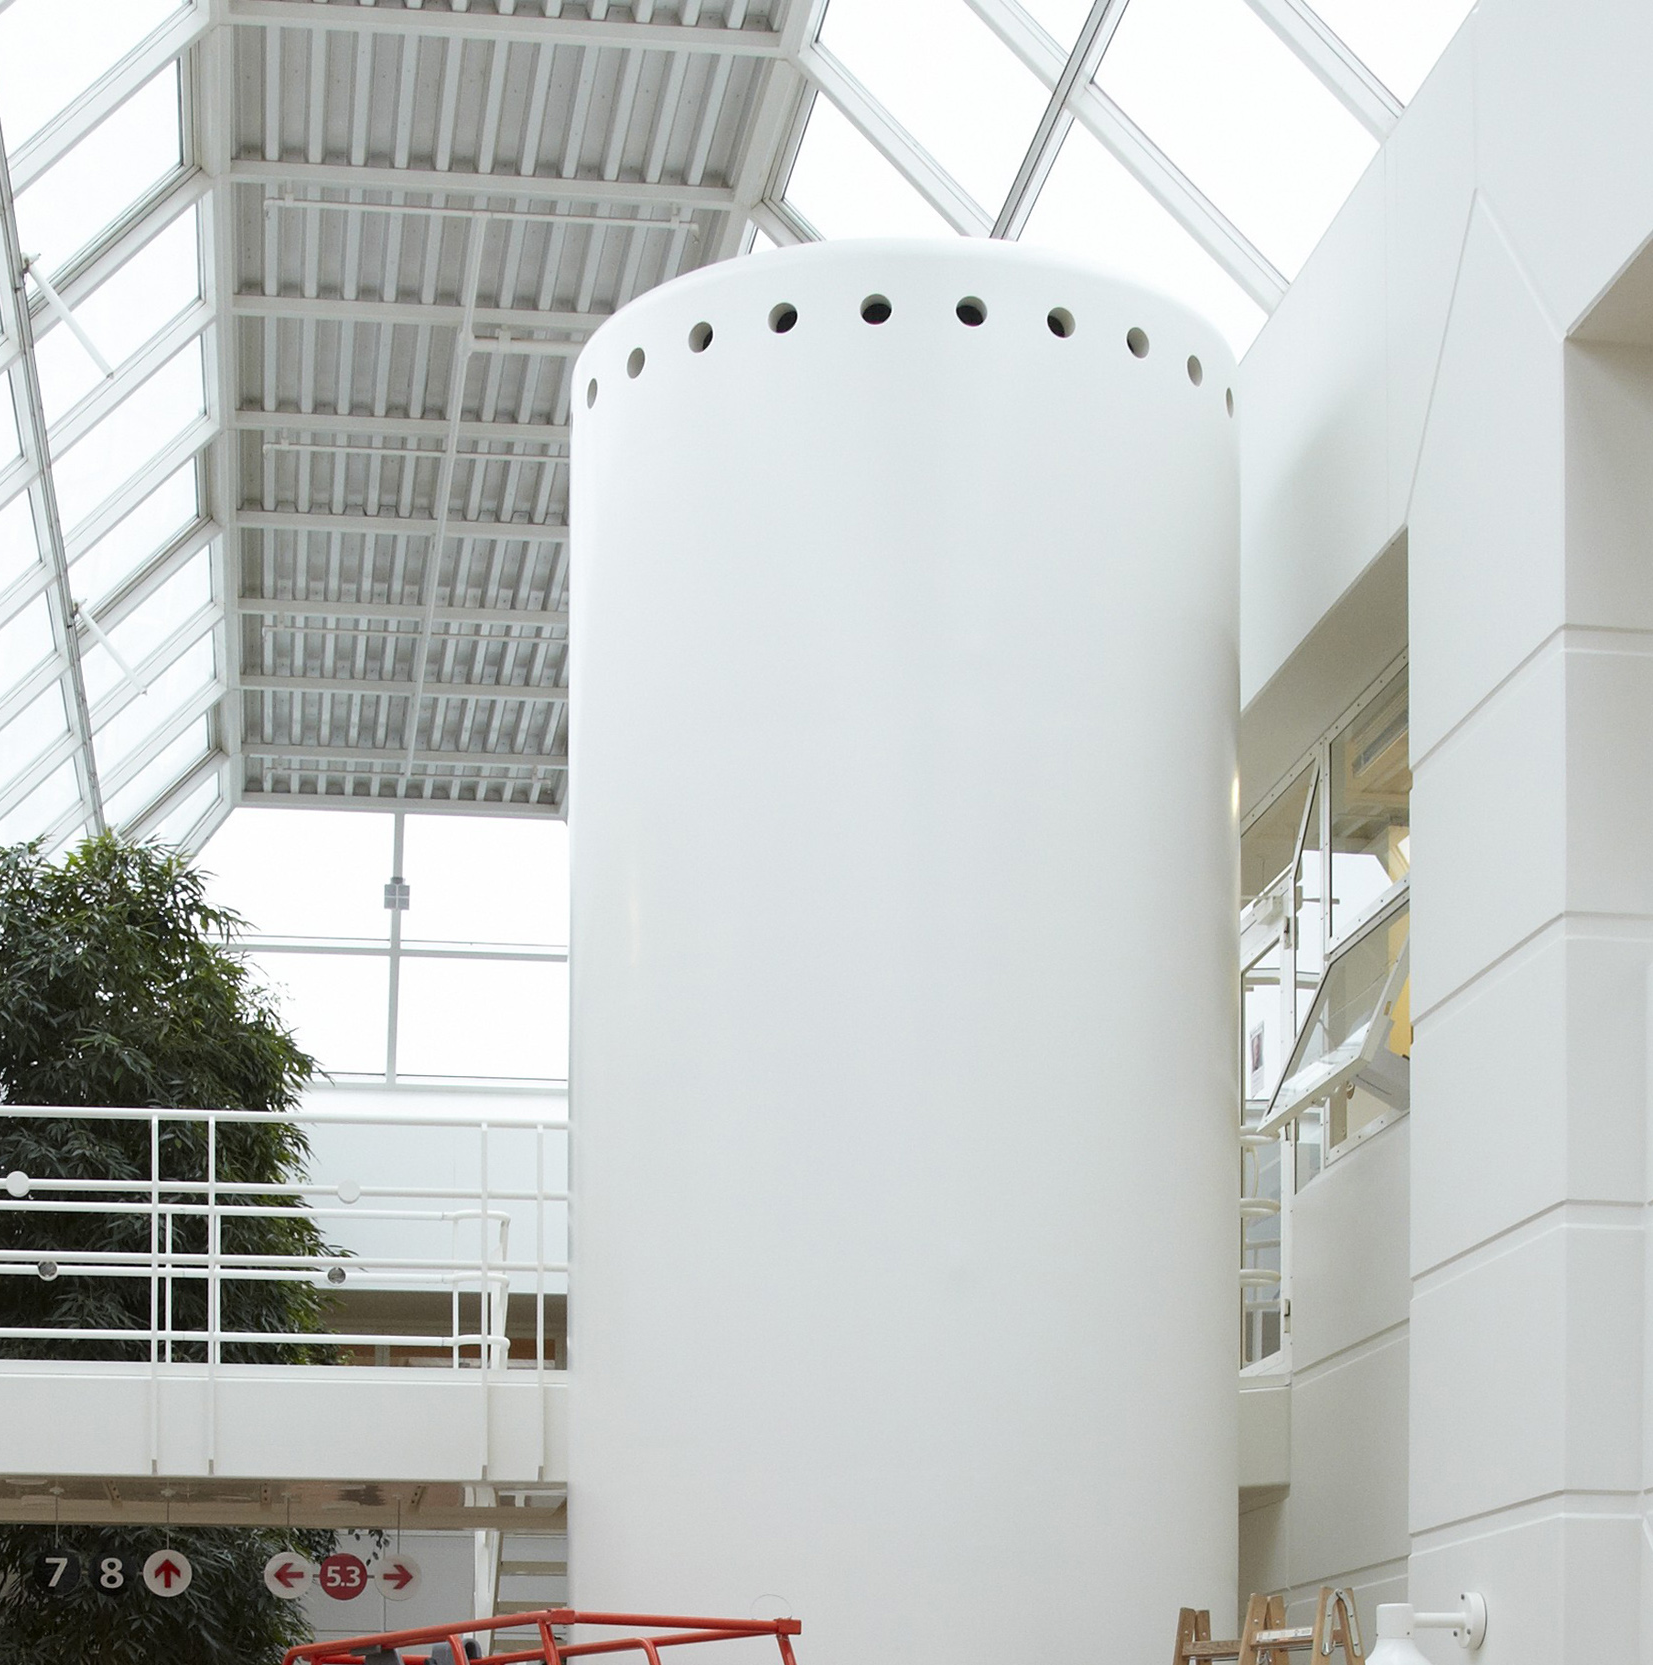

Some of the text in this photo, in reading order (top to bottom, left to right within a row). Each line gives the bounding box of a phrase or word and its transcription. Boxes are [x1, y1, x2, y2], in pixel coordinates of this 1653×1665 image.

[45, 1557, 124, 1589] 7 8
[326, 1565, 361, 1588] 5.3
